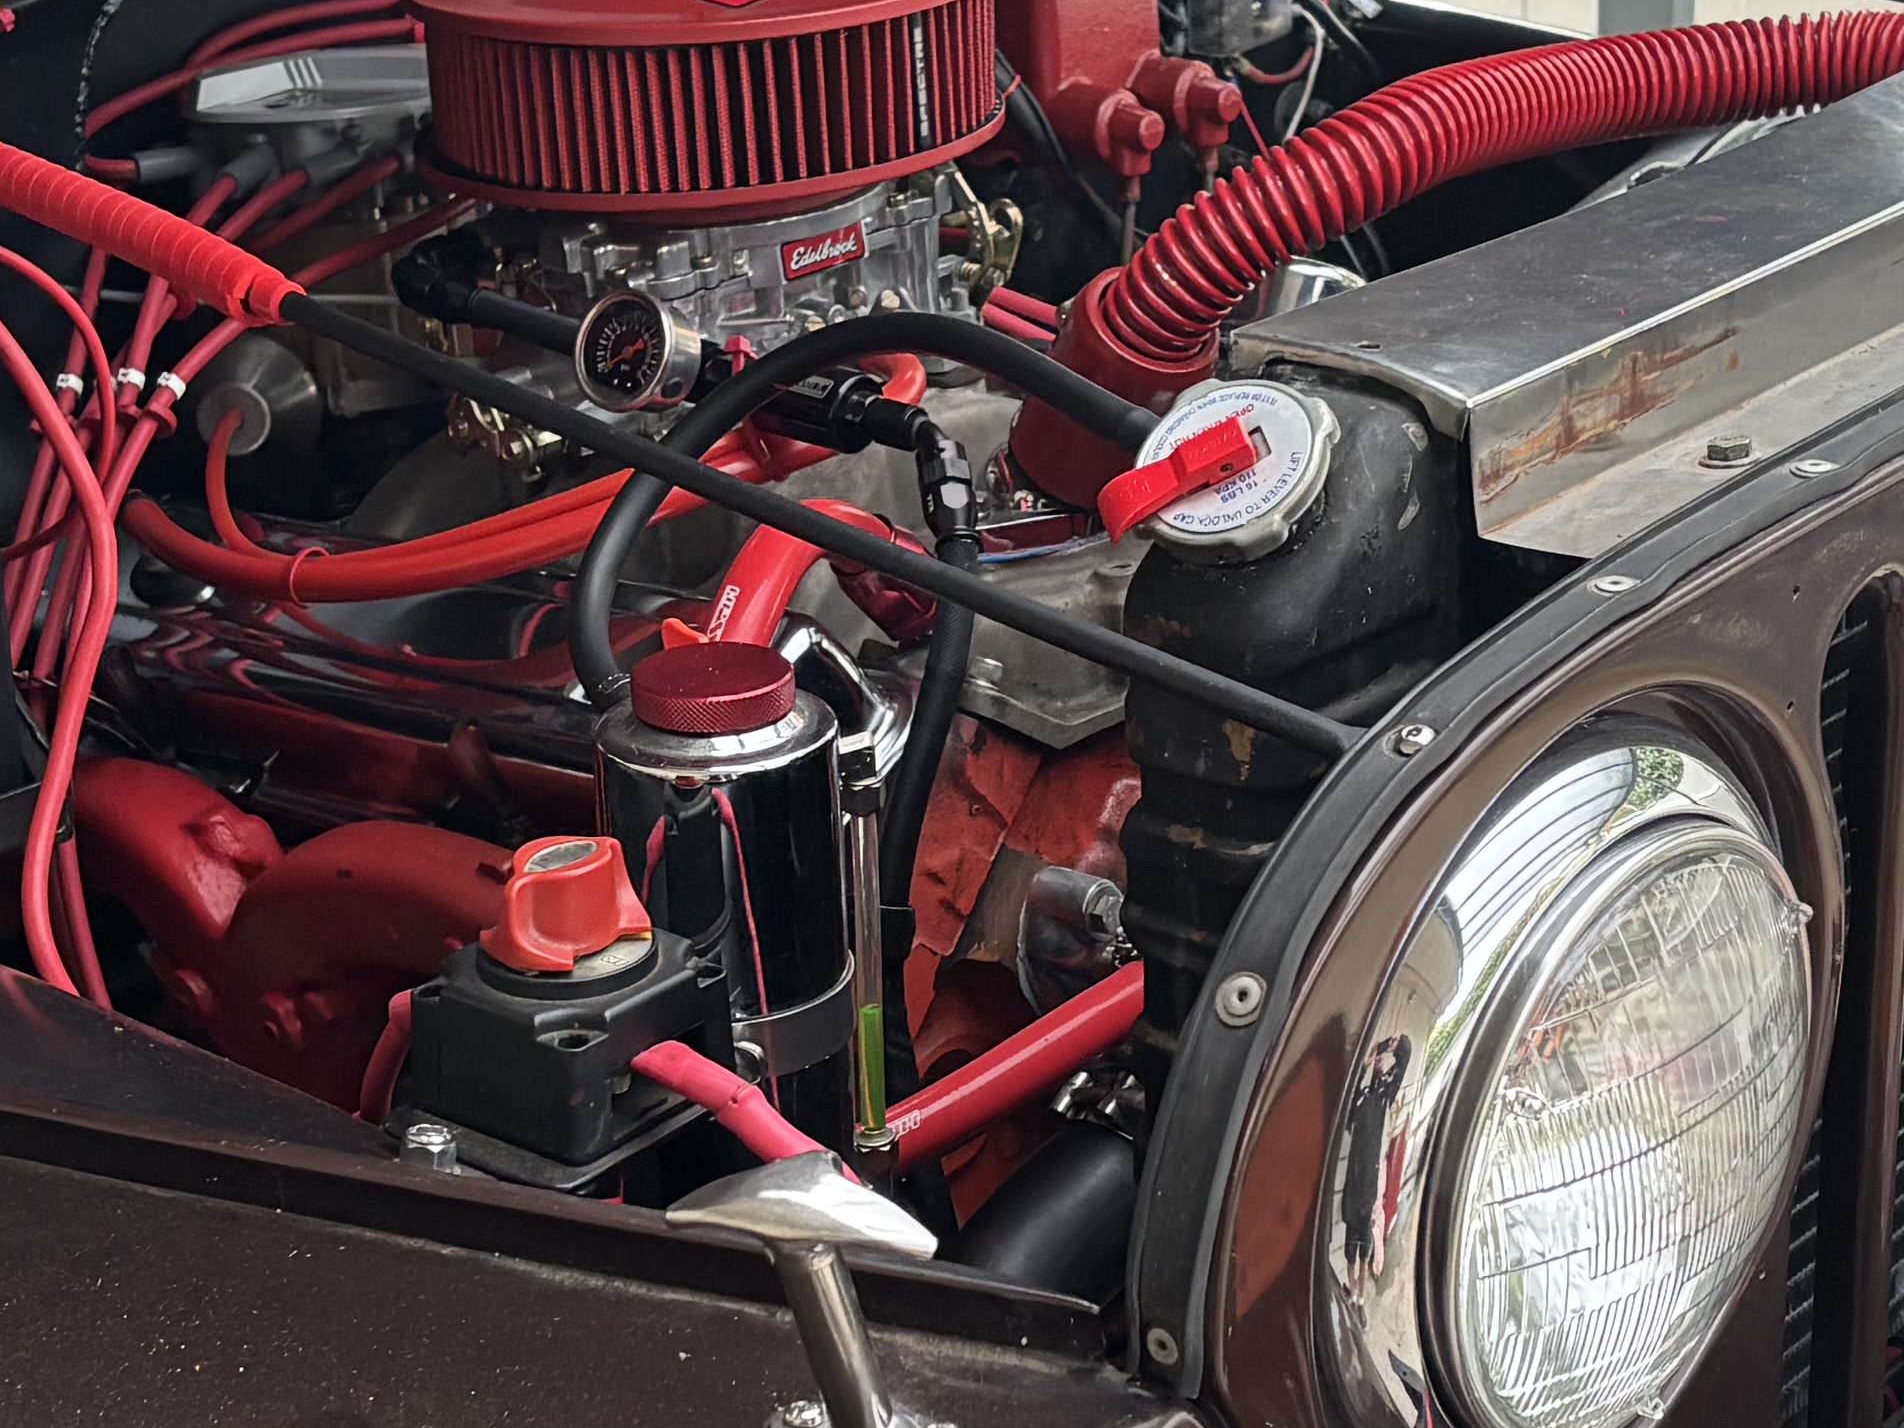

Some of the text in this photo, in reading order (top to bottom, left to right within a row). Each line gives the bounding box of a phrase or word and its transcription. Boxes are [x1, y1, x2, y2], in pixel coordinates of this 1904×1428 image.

[912, 26, 930, 137] SPECTRE
[790, 232, 858, 271] Edelbrock
[1261, 475, 1294, 504] LEVER
[1245, 501, 1264, 515] TO
